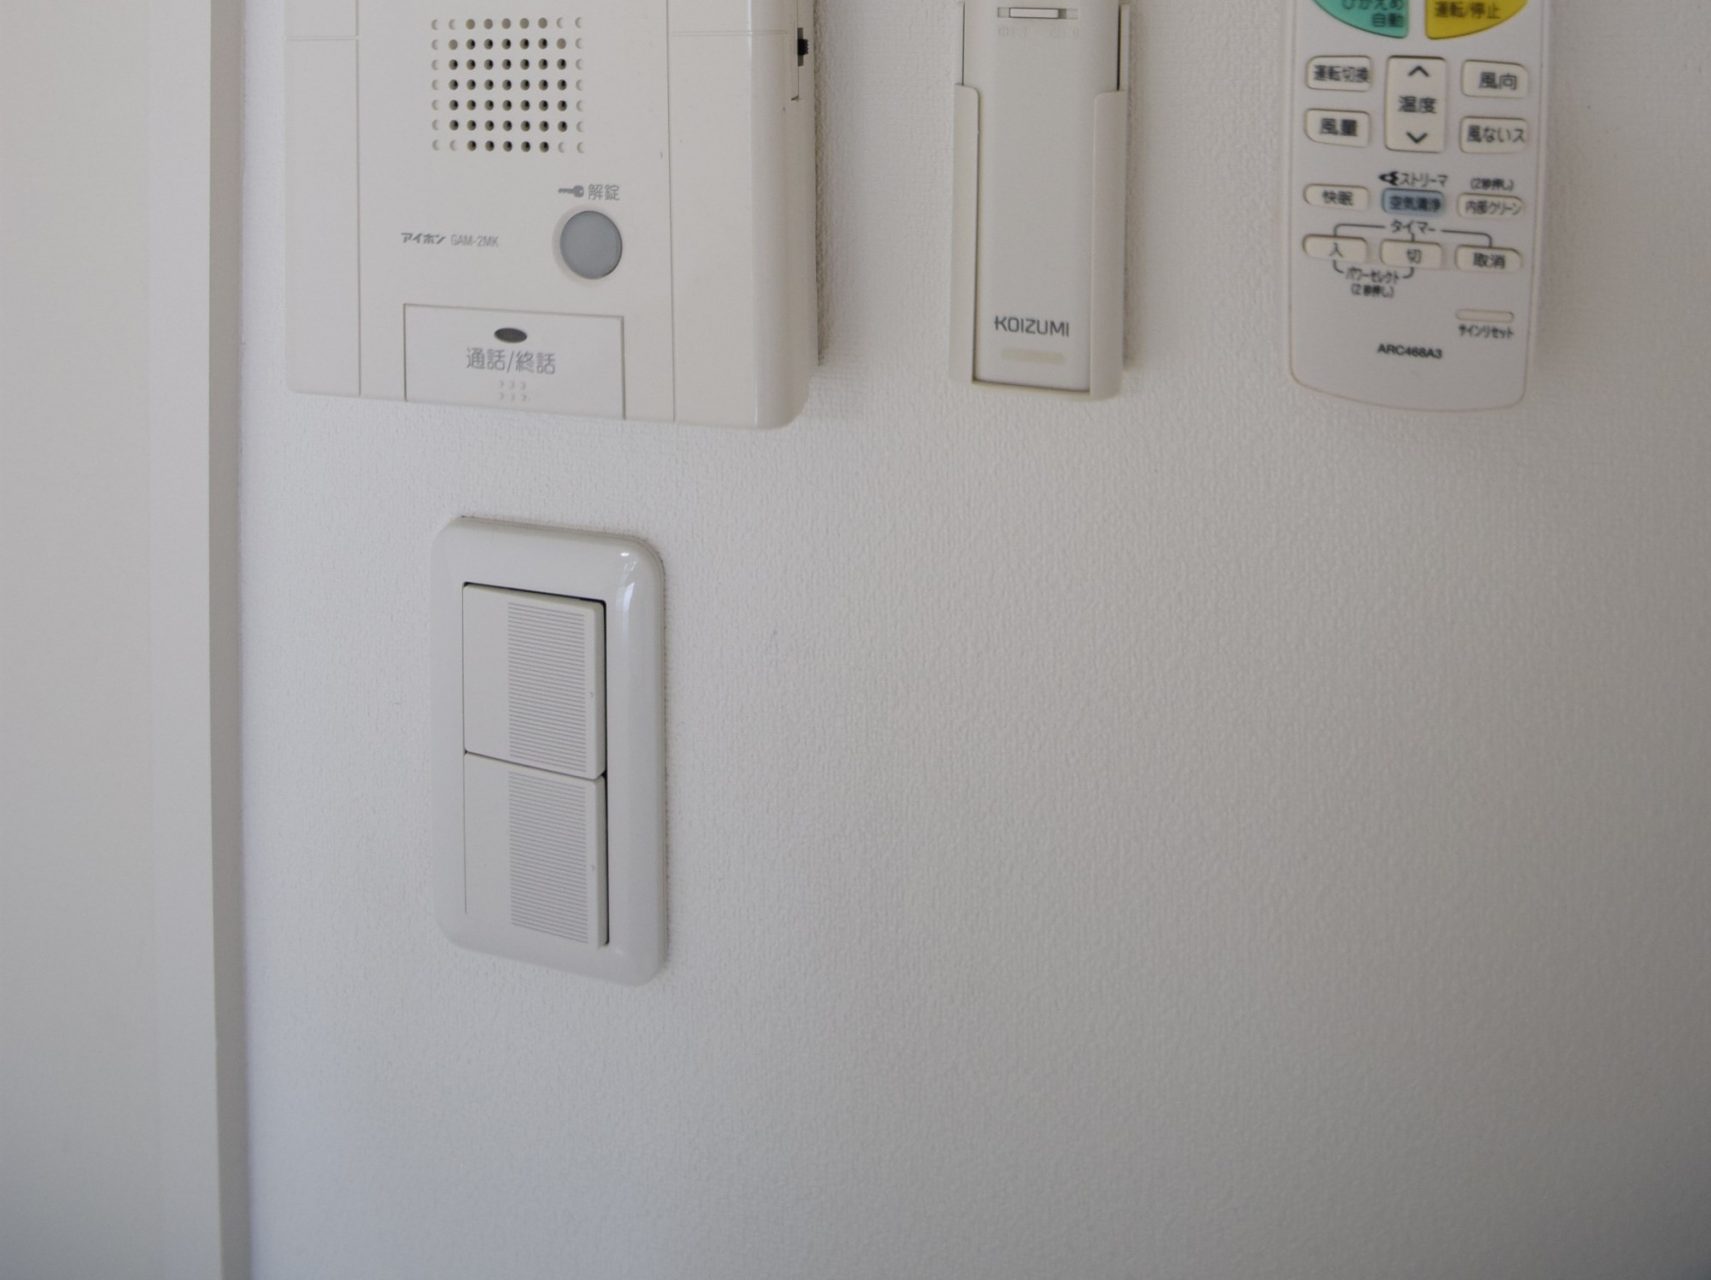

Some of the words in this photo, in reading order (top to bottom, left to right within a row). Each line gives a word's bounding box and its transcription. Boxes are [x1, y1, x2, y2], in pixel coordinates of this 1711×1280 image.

[1371, 12, 1404, 28] 自動
[1313, 64, 1369, 83] 運転切換
[1478, 72, 1517, 91] 風向
[1398, 95, 1437, 114] 温度
[1320, 118, 1358, 137] 風量
[1466, 125, 1525, 144] 風ないス
[1400, 173, 1448, 188] ストリーマ
[587, 184, 620, 201] 解錠
[1322, 190, 1354, 207] 快眠
[1389, 194, 1441, 213] 空気清浄
[1464, 199, 1522, 216] 内部クリーン
[1390, 220, 1437, 235] タイマー
[401, 232, 446, 245] アイホン
[1329, 242, 1344, 258] 入
[1406, 248, 1422, 264] 切
[1472, 252, 1507, 270] 取消
[1346, 267, 1400, 284] パワーセレクト
[994, 315, 1070, 338] KOIZUMI
[466, 348, 556, 376] 通話/終話
